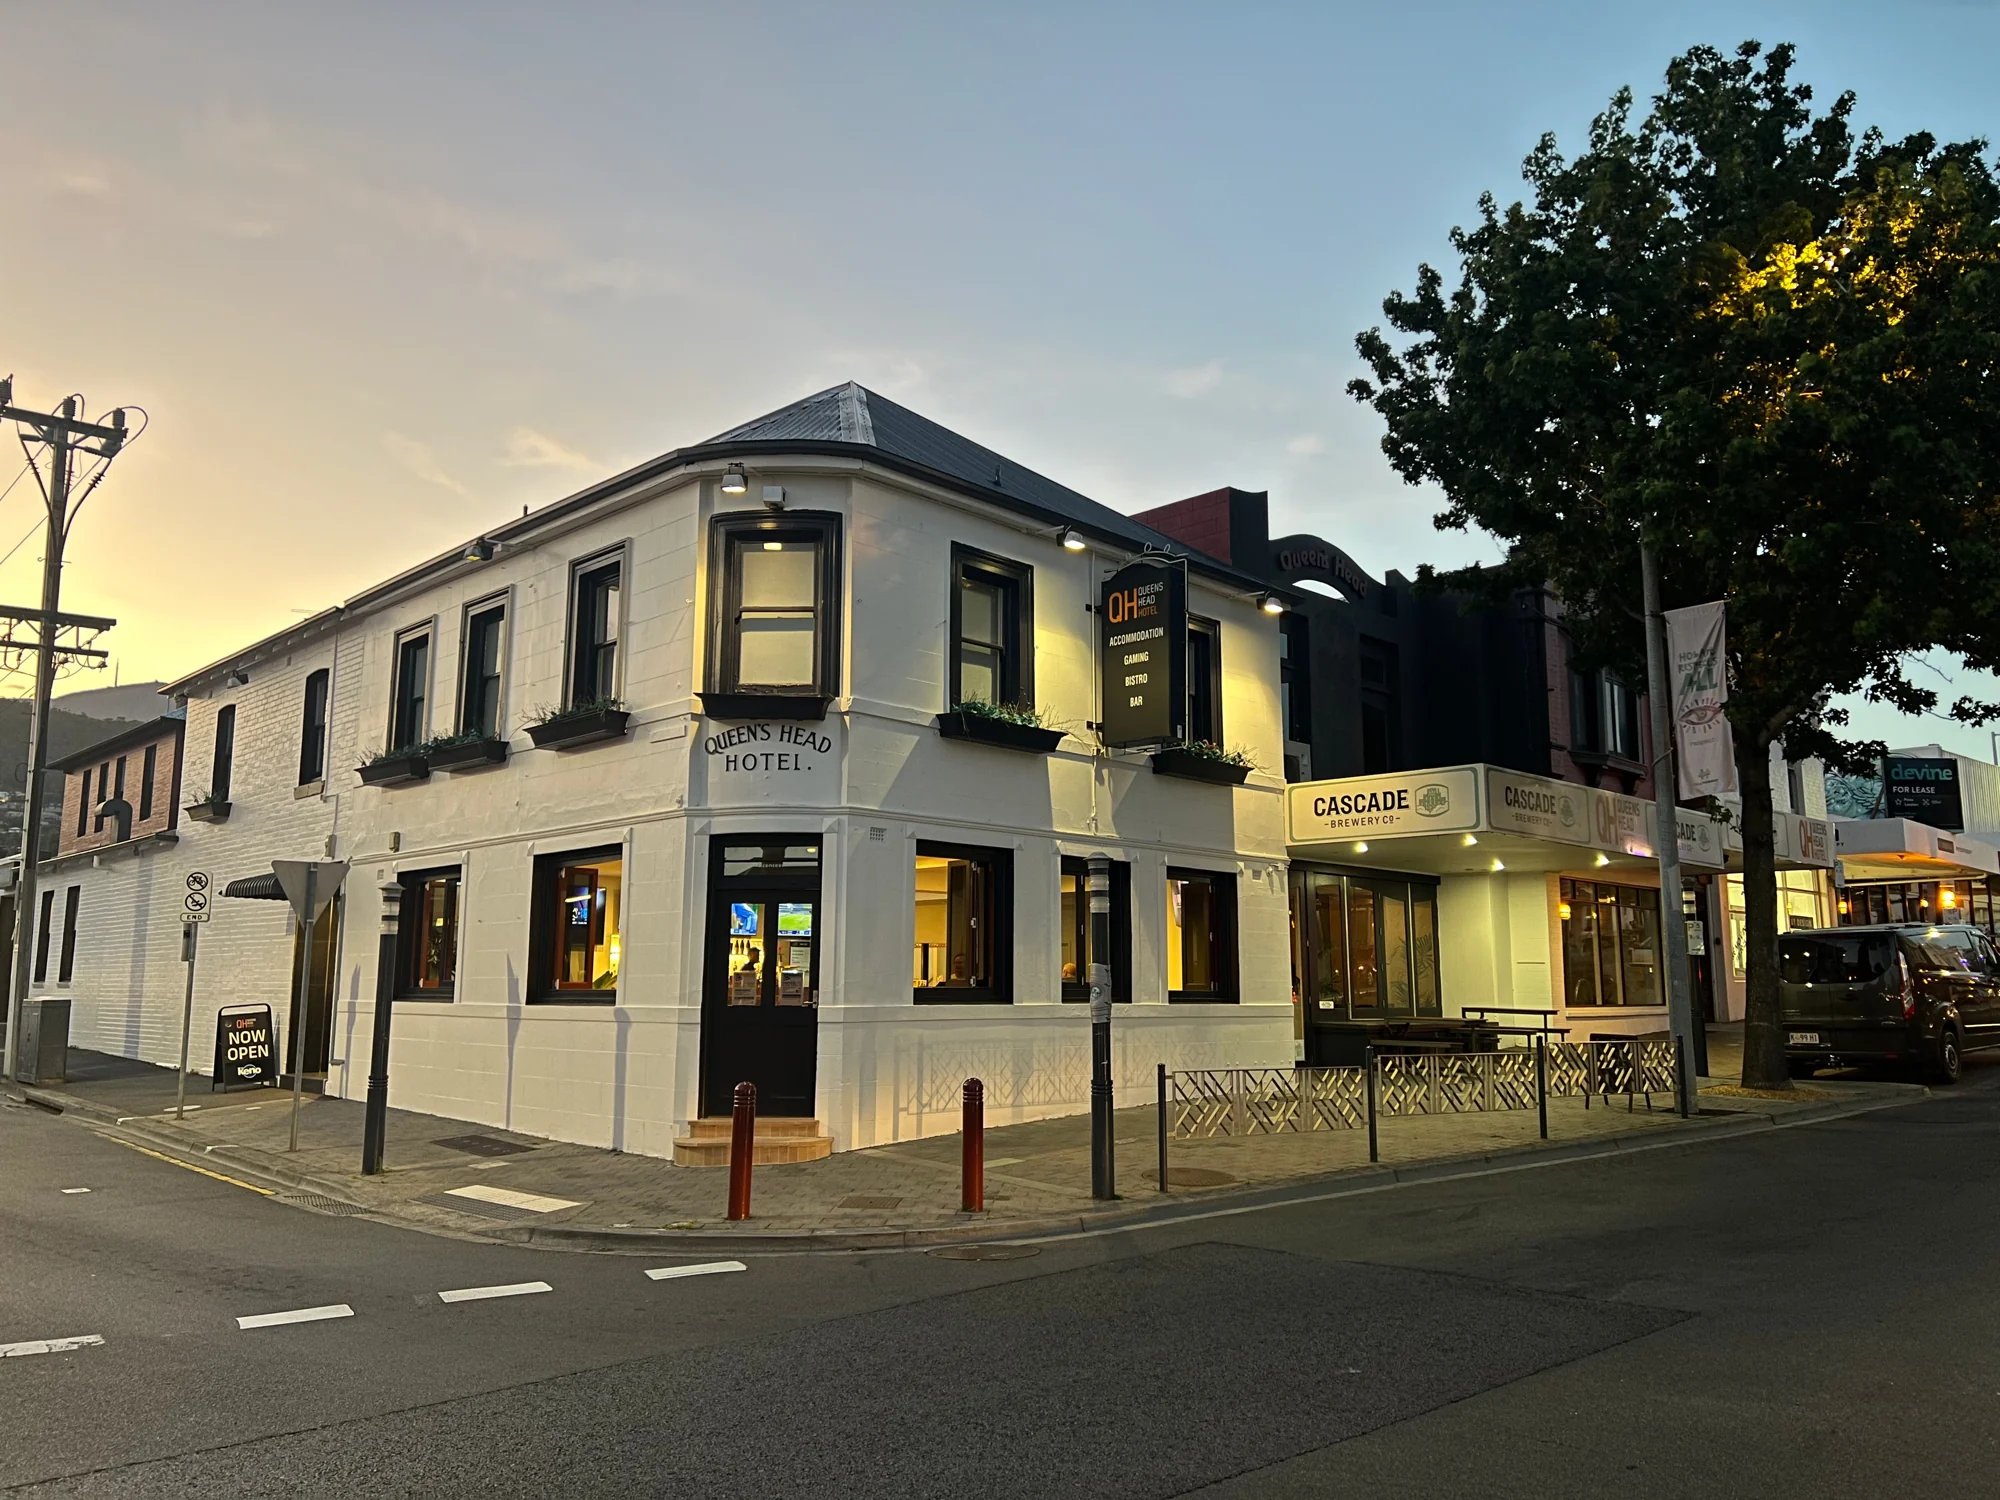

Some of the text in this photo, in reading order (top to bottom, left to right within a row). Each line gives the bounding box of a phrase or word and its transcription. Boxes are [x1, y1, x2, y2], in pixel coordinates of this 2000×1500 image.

[1335, 556, 1368, 598] Head
[1138, 581, 1164, 596] QUEENS
[1108, 587, 1138, 624] QH
[1138, 594, 1156, 608] HEAD
[1138, 605, 1159, 617] HOTEL
[1109, 626, 1164, 647] ACCOMMODATION
[1123, 651, 1149, 666] GAMING
[1125, 673, 1148, 687] BISTRO
[1129, 695, 1143, 708] BAR
[704, 723, 832, 755] QUEEN'S HEAD
[1891, 763, 1953, 780] devine
[1911, 786, 1936, 794] LEASE
[1313, 789, 1410, 817] CASCADE
[1504, 785, 1557, 815] CASCADE
[1617, 799, 1640, 817] QUEENS
[1595, 794, 1619, 846] QH
[1618, 815, 1635, 831] HEAD
[1675, 821, 1697, 841] CADE
[228, 1029, 266, 1045] NOW
[227, 1044, 269, 1061] OPEN
[237, 1067, 262, 1076] Keno
